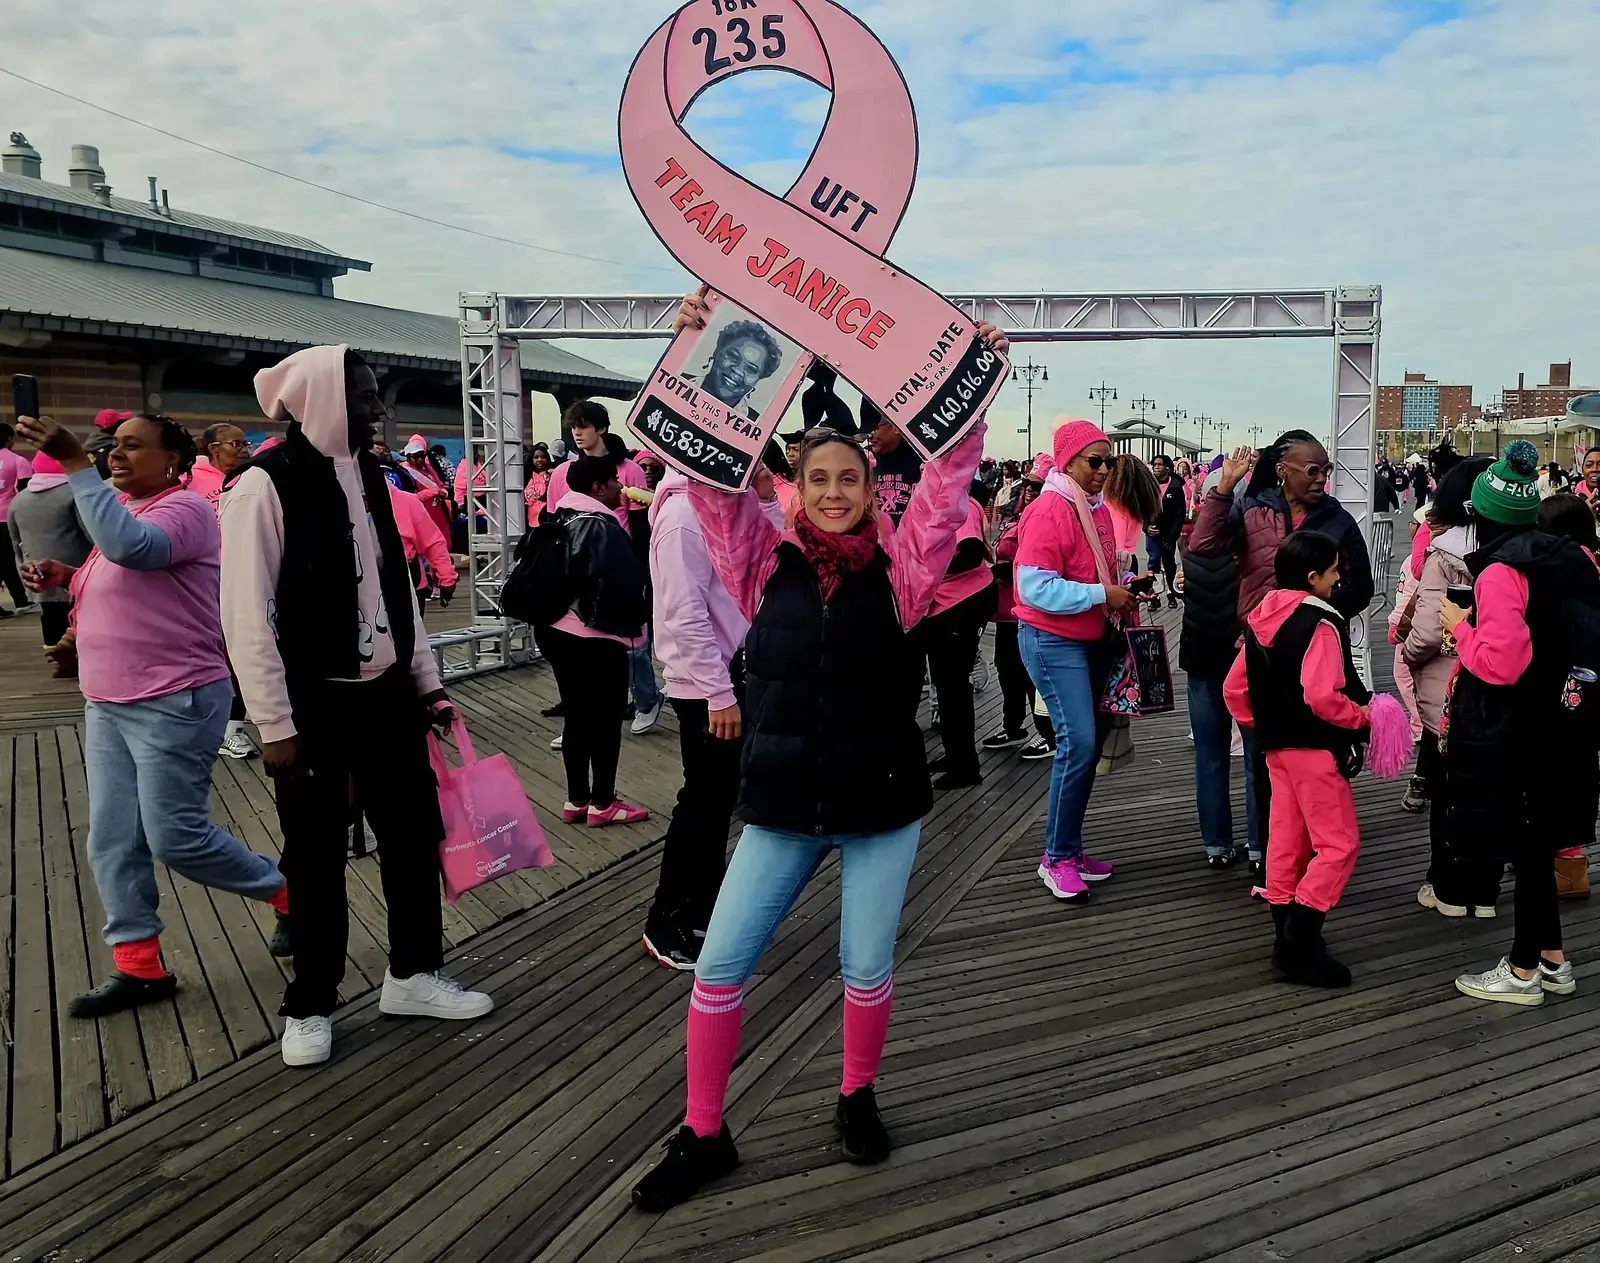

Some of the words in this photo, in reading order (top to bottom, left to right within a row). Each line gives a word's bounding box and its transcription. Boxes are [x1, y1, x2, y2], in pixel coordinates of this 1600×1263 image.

[692, 14, 786, 76] 235
[810, 176, 878, 233] UFT
[654, 157, 748, 256] TEAM
[746, 238, 896, 350] JANICE
[884, 372, 928, 413] TOTAL
[922, 362, 933, 372] TO
[928, 321, 965, 363] DATE
[925, 381, 936, 391] SO
[656, 368, 700, 408] TOTAL
[701, 400, 721, 417] THIS
[724, 411, 762, 441] YEAR
[689, 410, 700, 420] SO
[476, 830, 497, 844] Cancer
[497, 819, 519, 833] Center
